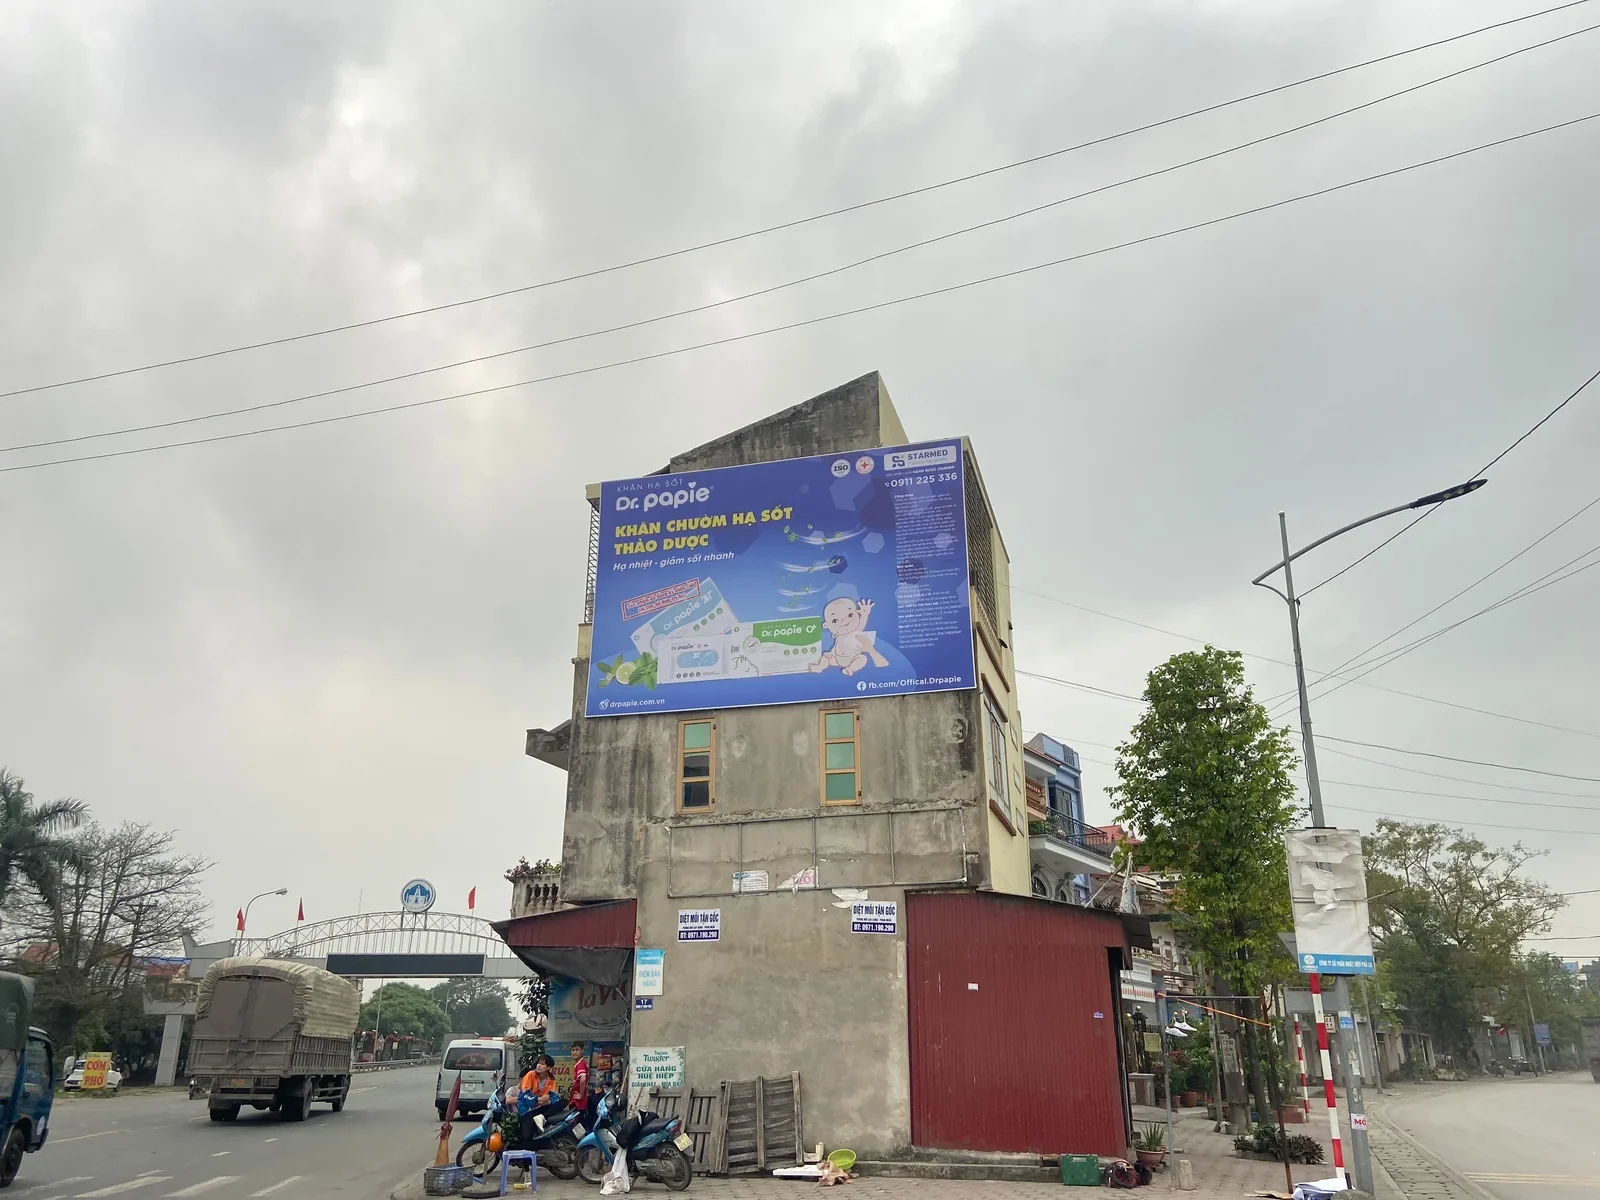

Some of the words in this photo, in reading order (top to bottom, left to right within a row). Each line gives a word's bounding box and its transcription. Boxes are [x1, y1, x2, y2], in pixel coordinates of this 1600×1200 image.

[907, 449, 949, 461] STARMED
[833, 464, 849, 472] ISO
[665, 478, 683, 488] SỐT
[890, 477, 913, 488] 0911
[916, 475, 935, 485] 225
[938, 472, 958, 482] 336
[615, 496, 640, 512] Dr.
[643, 482, 711, 512] papie
[615, 520, 661, 538] KHĂN
[666, 513, 727, 532] CHƯỜM
[732, 511, 757, 527] HẠ
[760, 504, 793, 522] SỐT
[614, 537, 658, 556] THẢO
[663, 534, 709, 551] DƯỢC
[613, 562, 627, 572] Hạ
[628, 560, 652, 569] nhiệt
[659, 556, 685, 569] giảm
[687, 553, 702, 564] sốt
[703, 551, 735, 562] nhanh
[663, 620, 675, 631] Dr.
[674, 602, 701, 624] papie
[773, 624, 803, 638] papie
[868, 674, 962, 690] fb.com/Offical.Drpapie
[609, 698, 666, 709] drpapie.com.vn
[885, 903, 896, 916] GỐC
[643, 1054, 670, 1062] Twister
[551, 1064, 570, 1076] RỬA
[636, 1064, 653, 1072] CỬA
[654, 1064, 677, 1072] HÀNG
[83, 1073, 105, 1086] PHỞ
